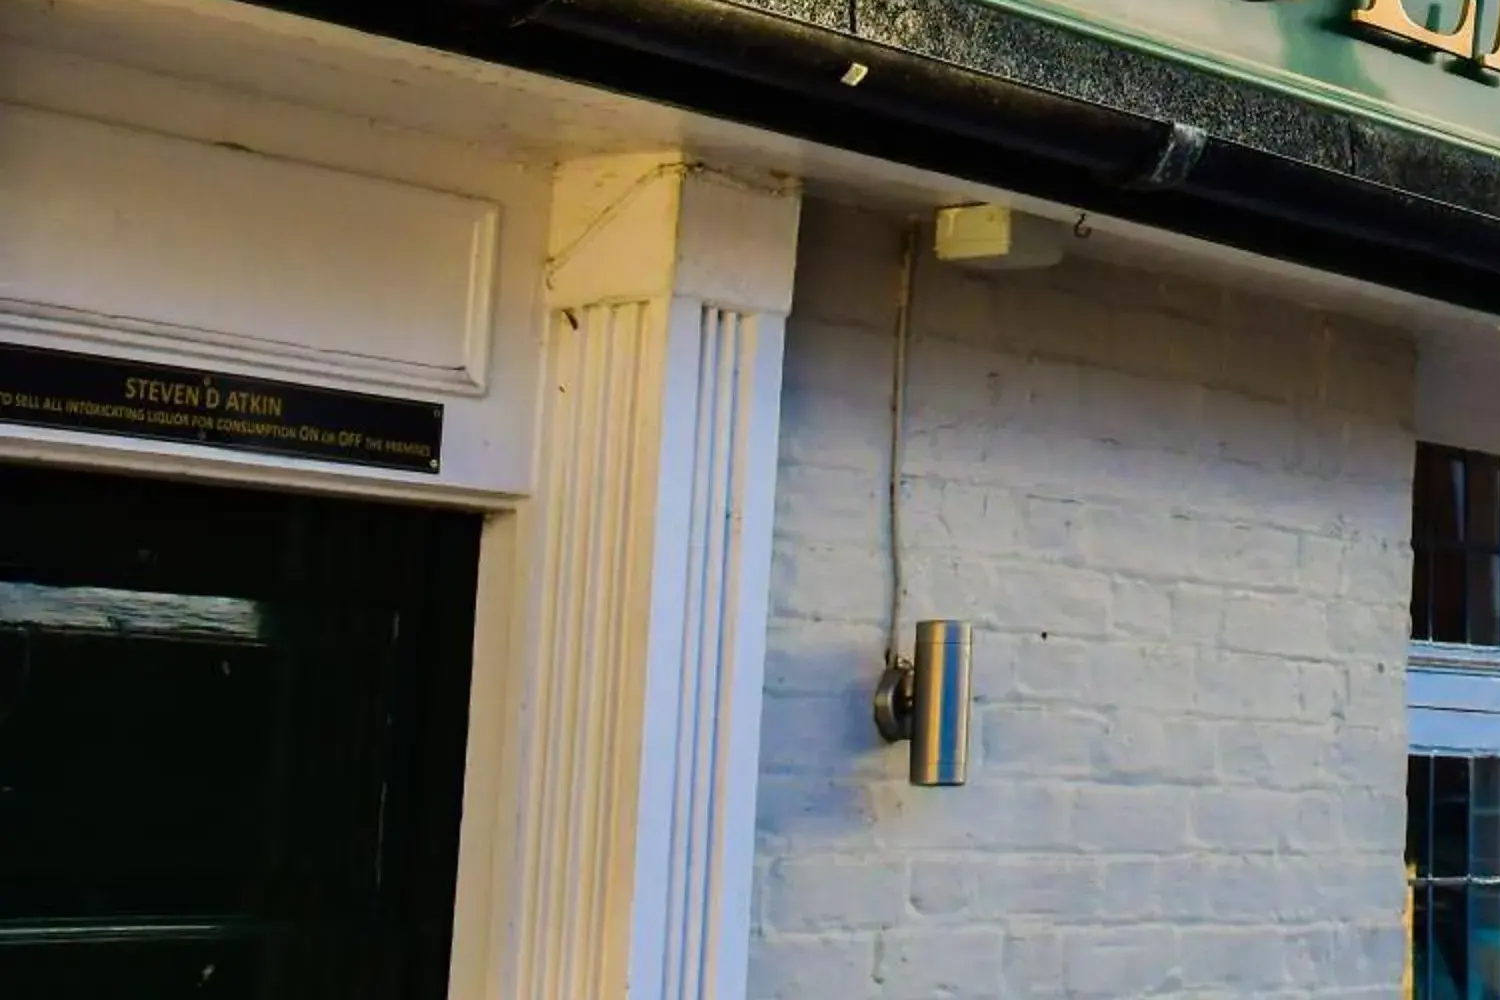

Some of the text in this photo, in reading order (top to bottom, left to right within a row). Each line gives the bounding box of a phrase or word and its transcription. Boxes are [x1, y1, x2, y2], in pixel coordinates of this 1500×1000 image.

[15, 391, 40, 409] SELL
[43, 396, 63, 412] ALL
[147, 411, 189, 426] LIQUOR
[191, 415, 214, 430] FOR
[216, 418, 297, 439] CONSUMPTION
[299, 425, 320, 442] ON
[338, 431, 363, 448] OFF
[125, 377, 282, 416] STEVEN D ATKIN
